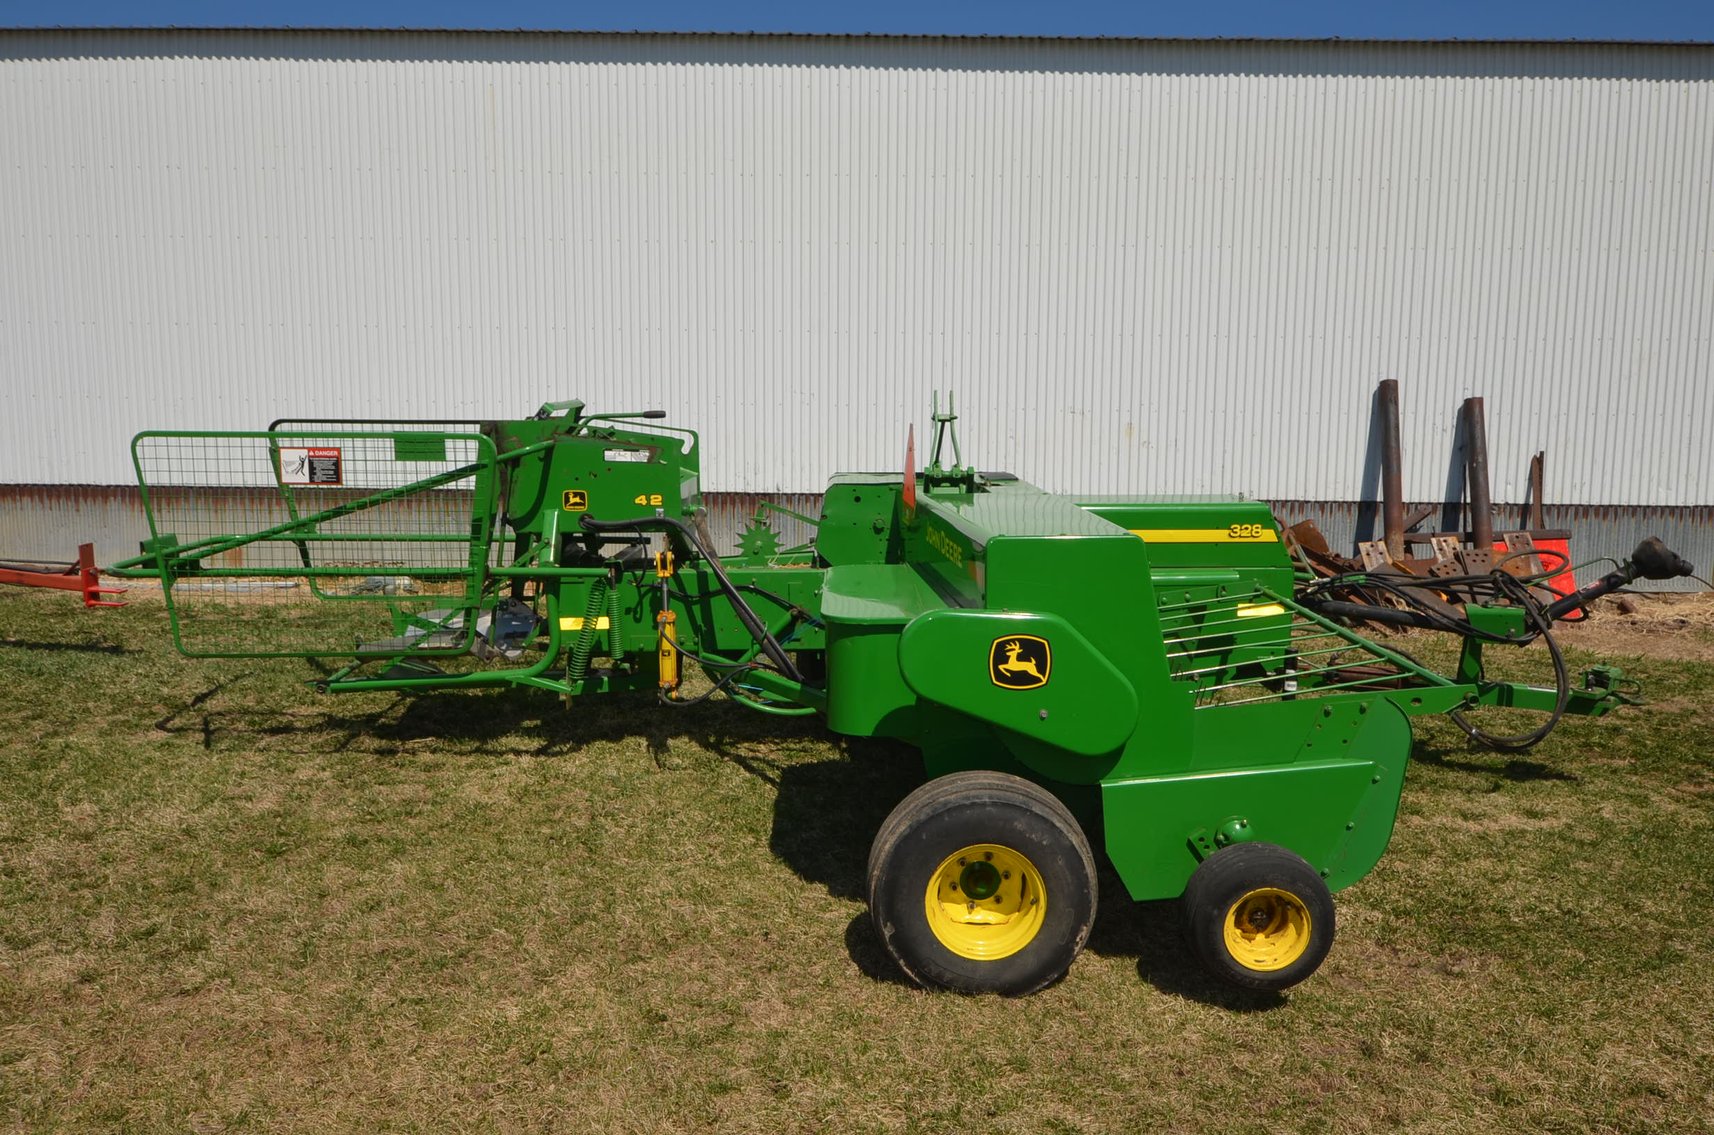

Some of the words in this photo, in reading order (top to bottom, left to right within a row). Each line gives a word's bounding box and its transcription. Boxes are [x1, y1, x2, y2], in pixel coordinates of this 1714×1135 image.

[634, 494, 663, 506] 42
[1229, 524, 1263, 538] 328
[926, 526, 941, 550] JOHN
[941, 530, 963, 568] DEERE
